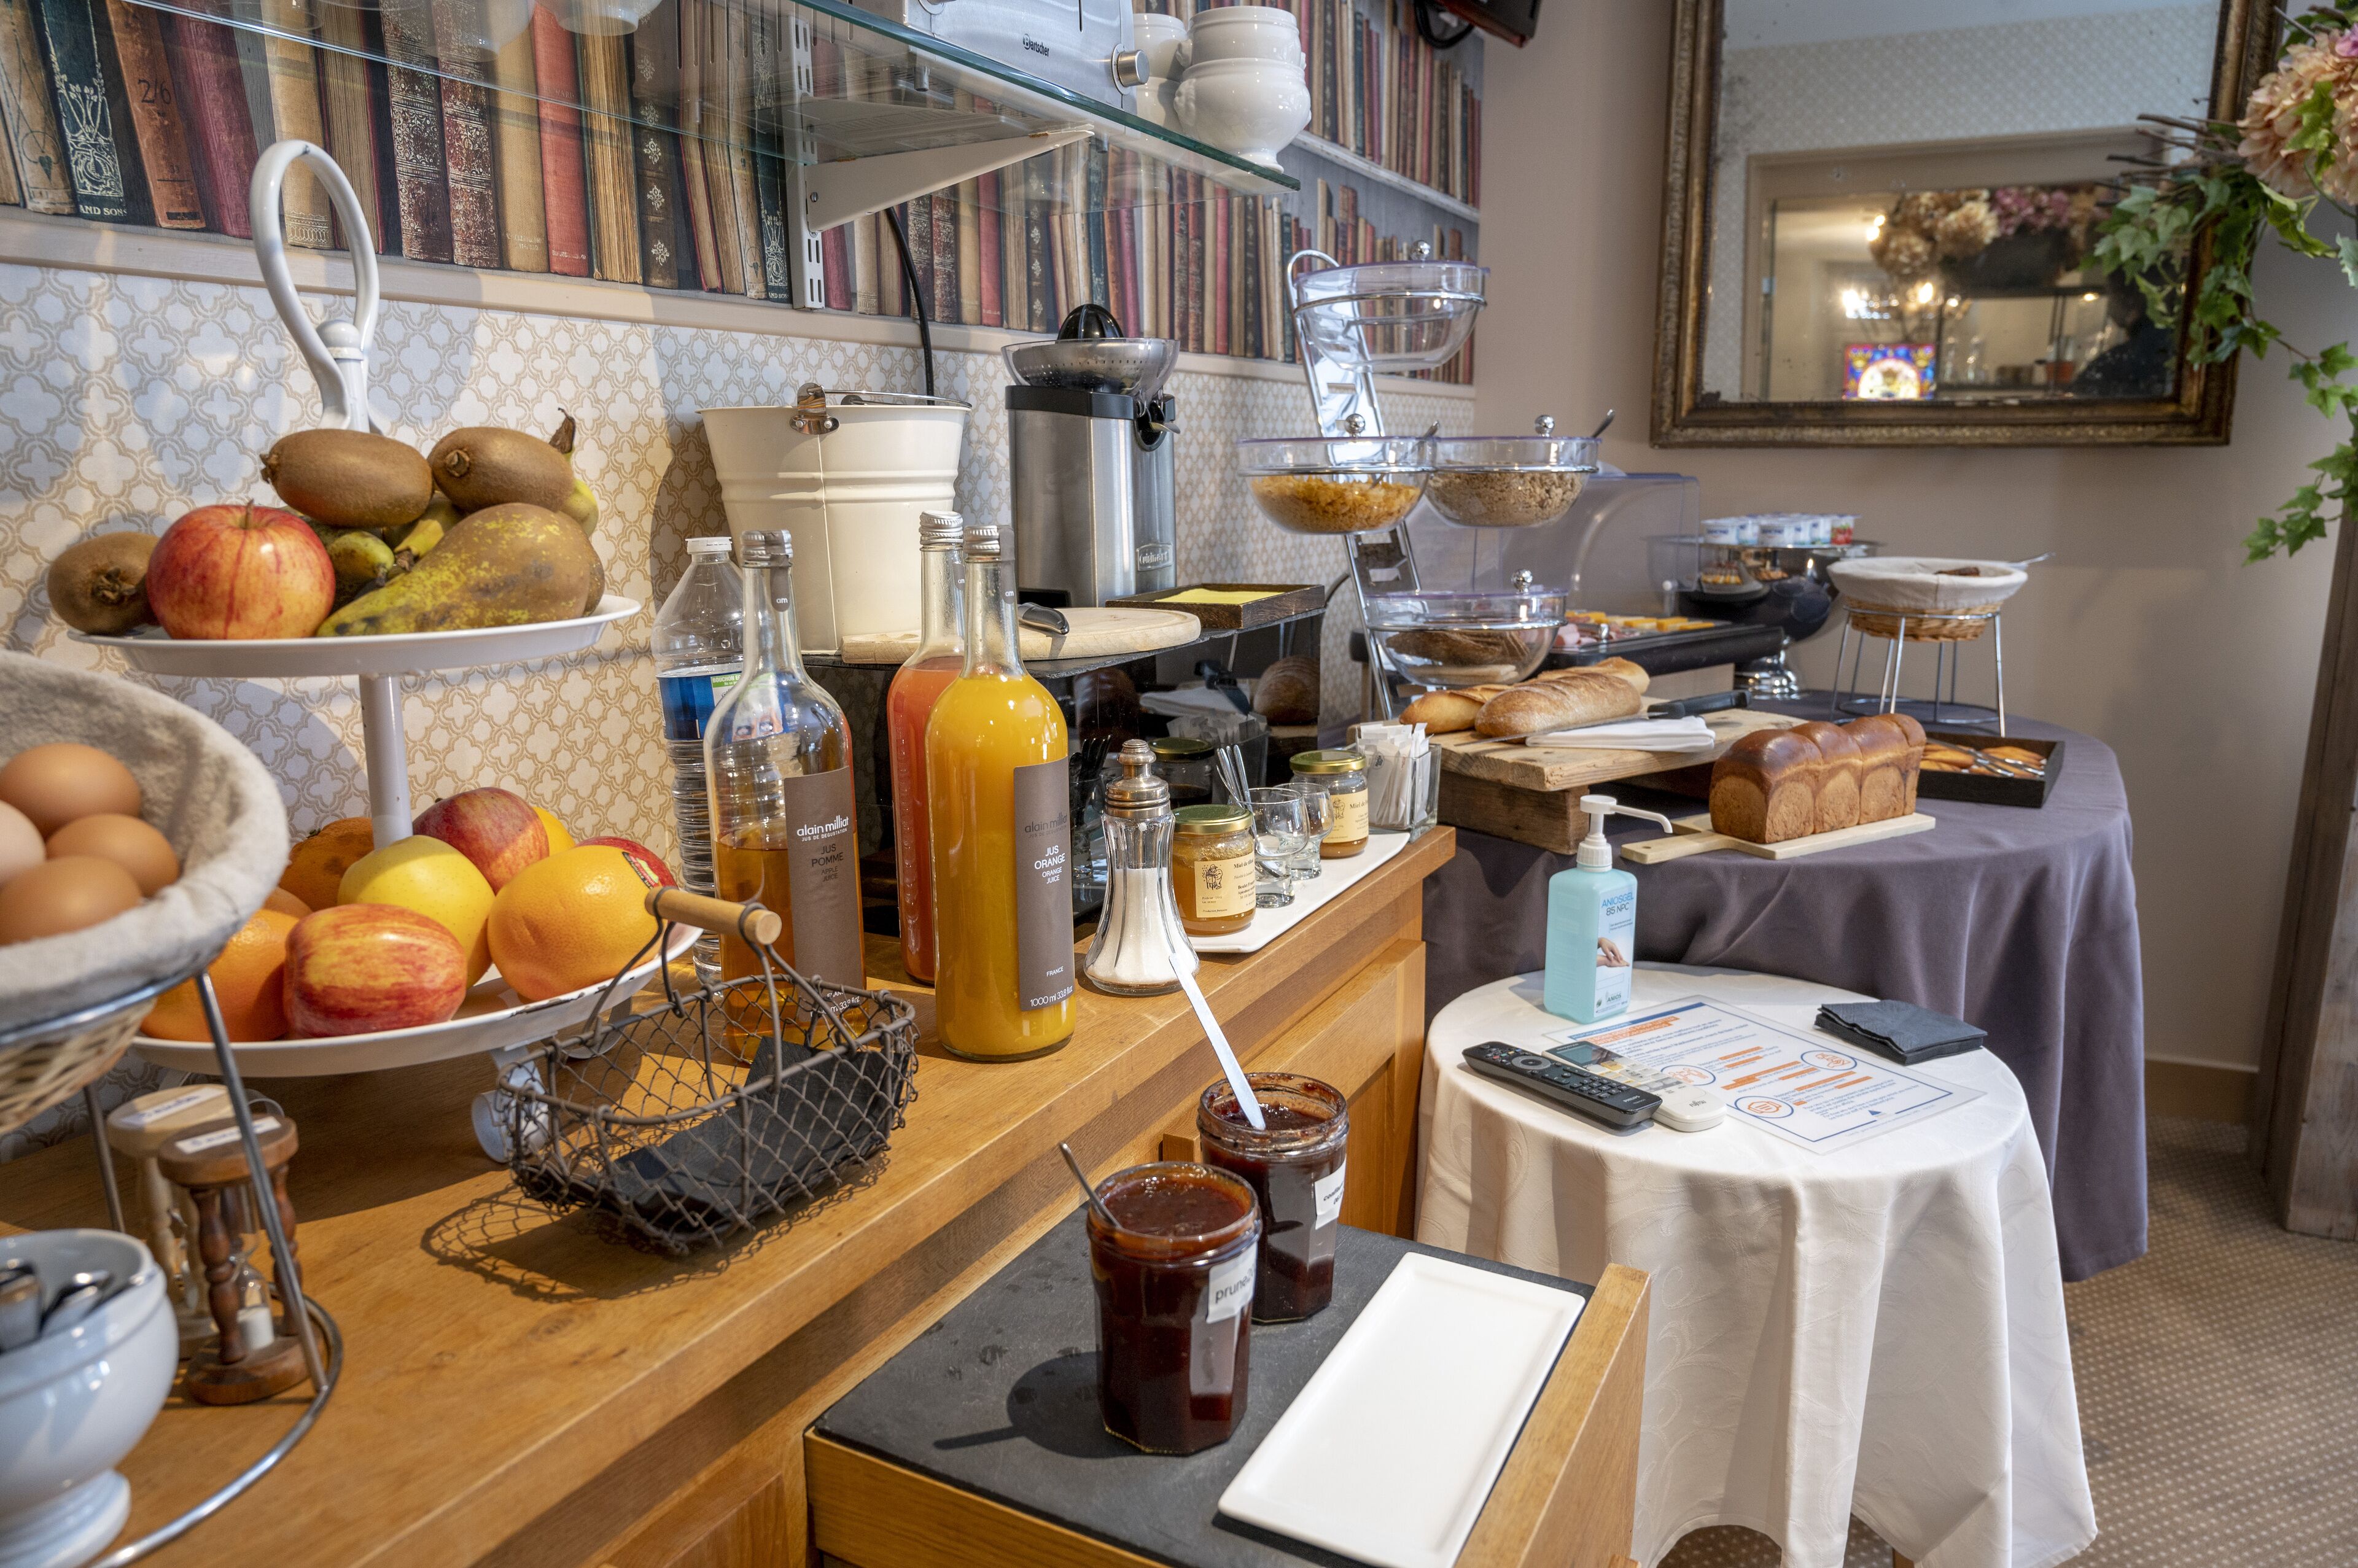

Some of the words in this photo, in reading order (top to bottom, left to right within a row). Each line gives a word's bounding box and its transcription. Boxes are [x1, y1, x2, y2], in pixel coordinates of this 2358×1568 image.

[1022, 33, 1049, 56] Bartscher
[79, 204, 101, 215] AND
[796, 824, 824, 837] alain
[825, 815, 849, 833] milliat
[1025, 821, 1049, 833] alain
[821, 828, 847, 839] DEGUSTATION
[820, 844, 836, 855] JUS
[1045, 845, 1059, 856] JUS
[811, 852, 844, 867] POMME
[1034, 853, 1065, 870] ORANGE
[820, 866, 839, 876] APPLE
[1041, 866, 1062, 878] ORANGE
[822, 873, 838, 882] JUICE
[1046, 874, 1060, 884] JUICE
[1601, 891, 1634, 908] ANIOSGEL
[1606, 906, 1616, 916] 85
[1616, 902, 1630, 914] NPC
[1046, 966, 1064, 977] FRANCE
[1030, 996, 1049, 1007] 1000
[1049, 993, 1056, 1003] ml
[1606, 993, 1622, 1003] ANIOS
